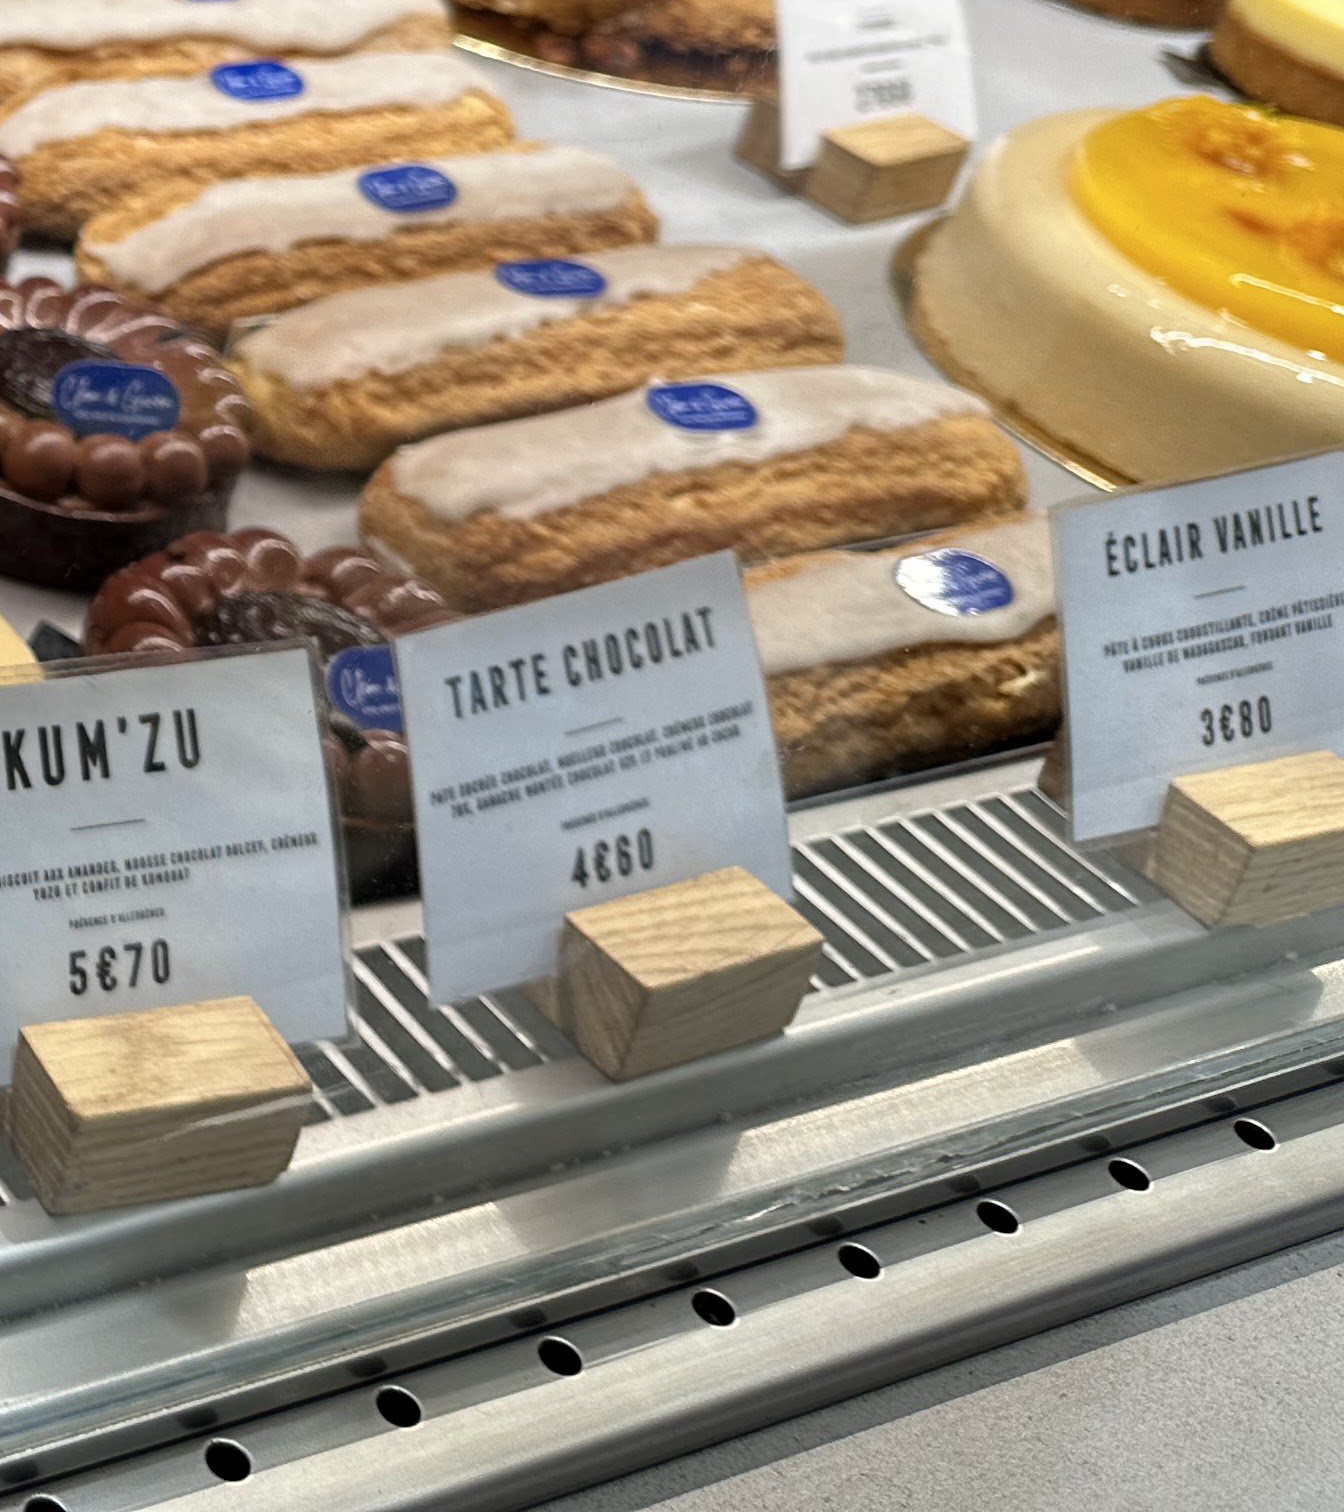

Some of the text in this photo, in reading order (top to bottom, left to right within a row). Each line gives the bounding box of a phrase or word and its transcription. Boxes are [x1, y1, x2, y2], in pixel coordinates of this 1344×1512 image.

[1103, 494, 1324, 579] ÉCLAIR VANILLE
[444, 651, 553, 720] TARTE
[561, 605, 715, 689] CHOCOLAT
[0, 708, 202, 792] KUM'ZU
[1200, 694, 1273, 747] 3€80
[571, 828, 655, 889] 4€60
[68, 938, 171, 997] 5€70
